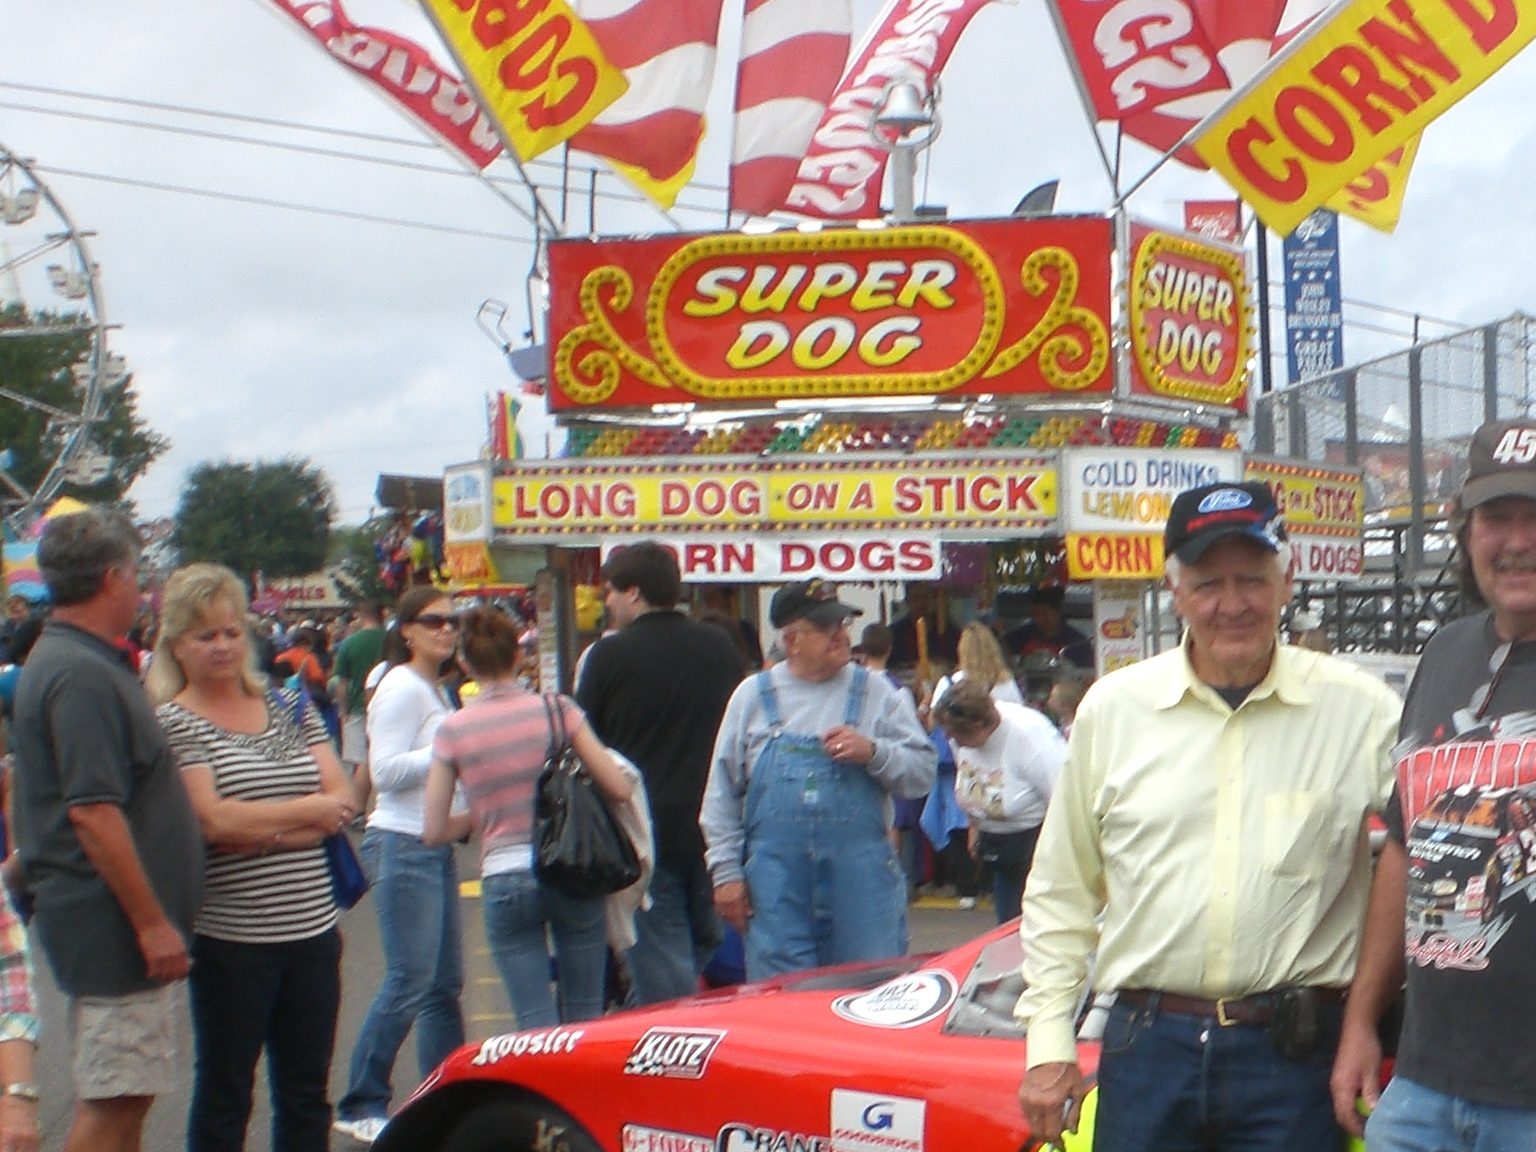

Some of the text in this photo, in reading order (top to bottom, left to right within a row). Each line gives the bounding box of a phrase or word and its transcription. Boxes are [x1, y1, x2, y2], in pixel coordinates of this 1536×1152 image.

[455, 0, 597, 131] COR
[1225, 0, 1462, 204] CORN
[682, 258, 957, 316] SUPER
[1144, 260, 1234, 326] SUPER
[724, 315, 923, 371] DOG
[1157, 318, 1224, 375] DOG
[1082, 457, 1220, 487] COLD DRINKS
[514, 475, 1040, 519] LONG DOG ON A STICK
[1083, 491, 1173, 523] LEMON
[1313, 486, 1358, 522] STICK
[780, 538, 935, 573] DOGS
[1077, 537, 1152, 573] CORN
[1309, 545, 1361, 574] DOGS
[471, 1027, 584, 1067] Hoosier
[637, 1034, 713, 1066] KLOTZ
